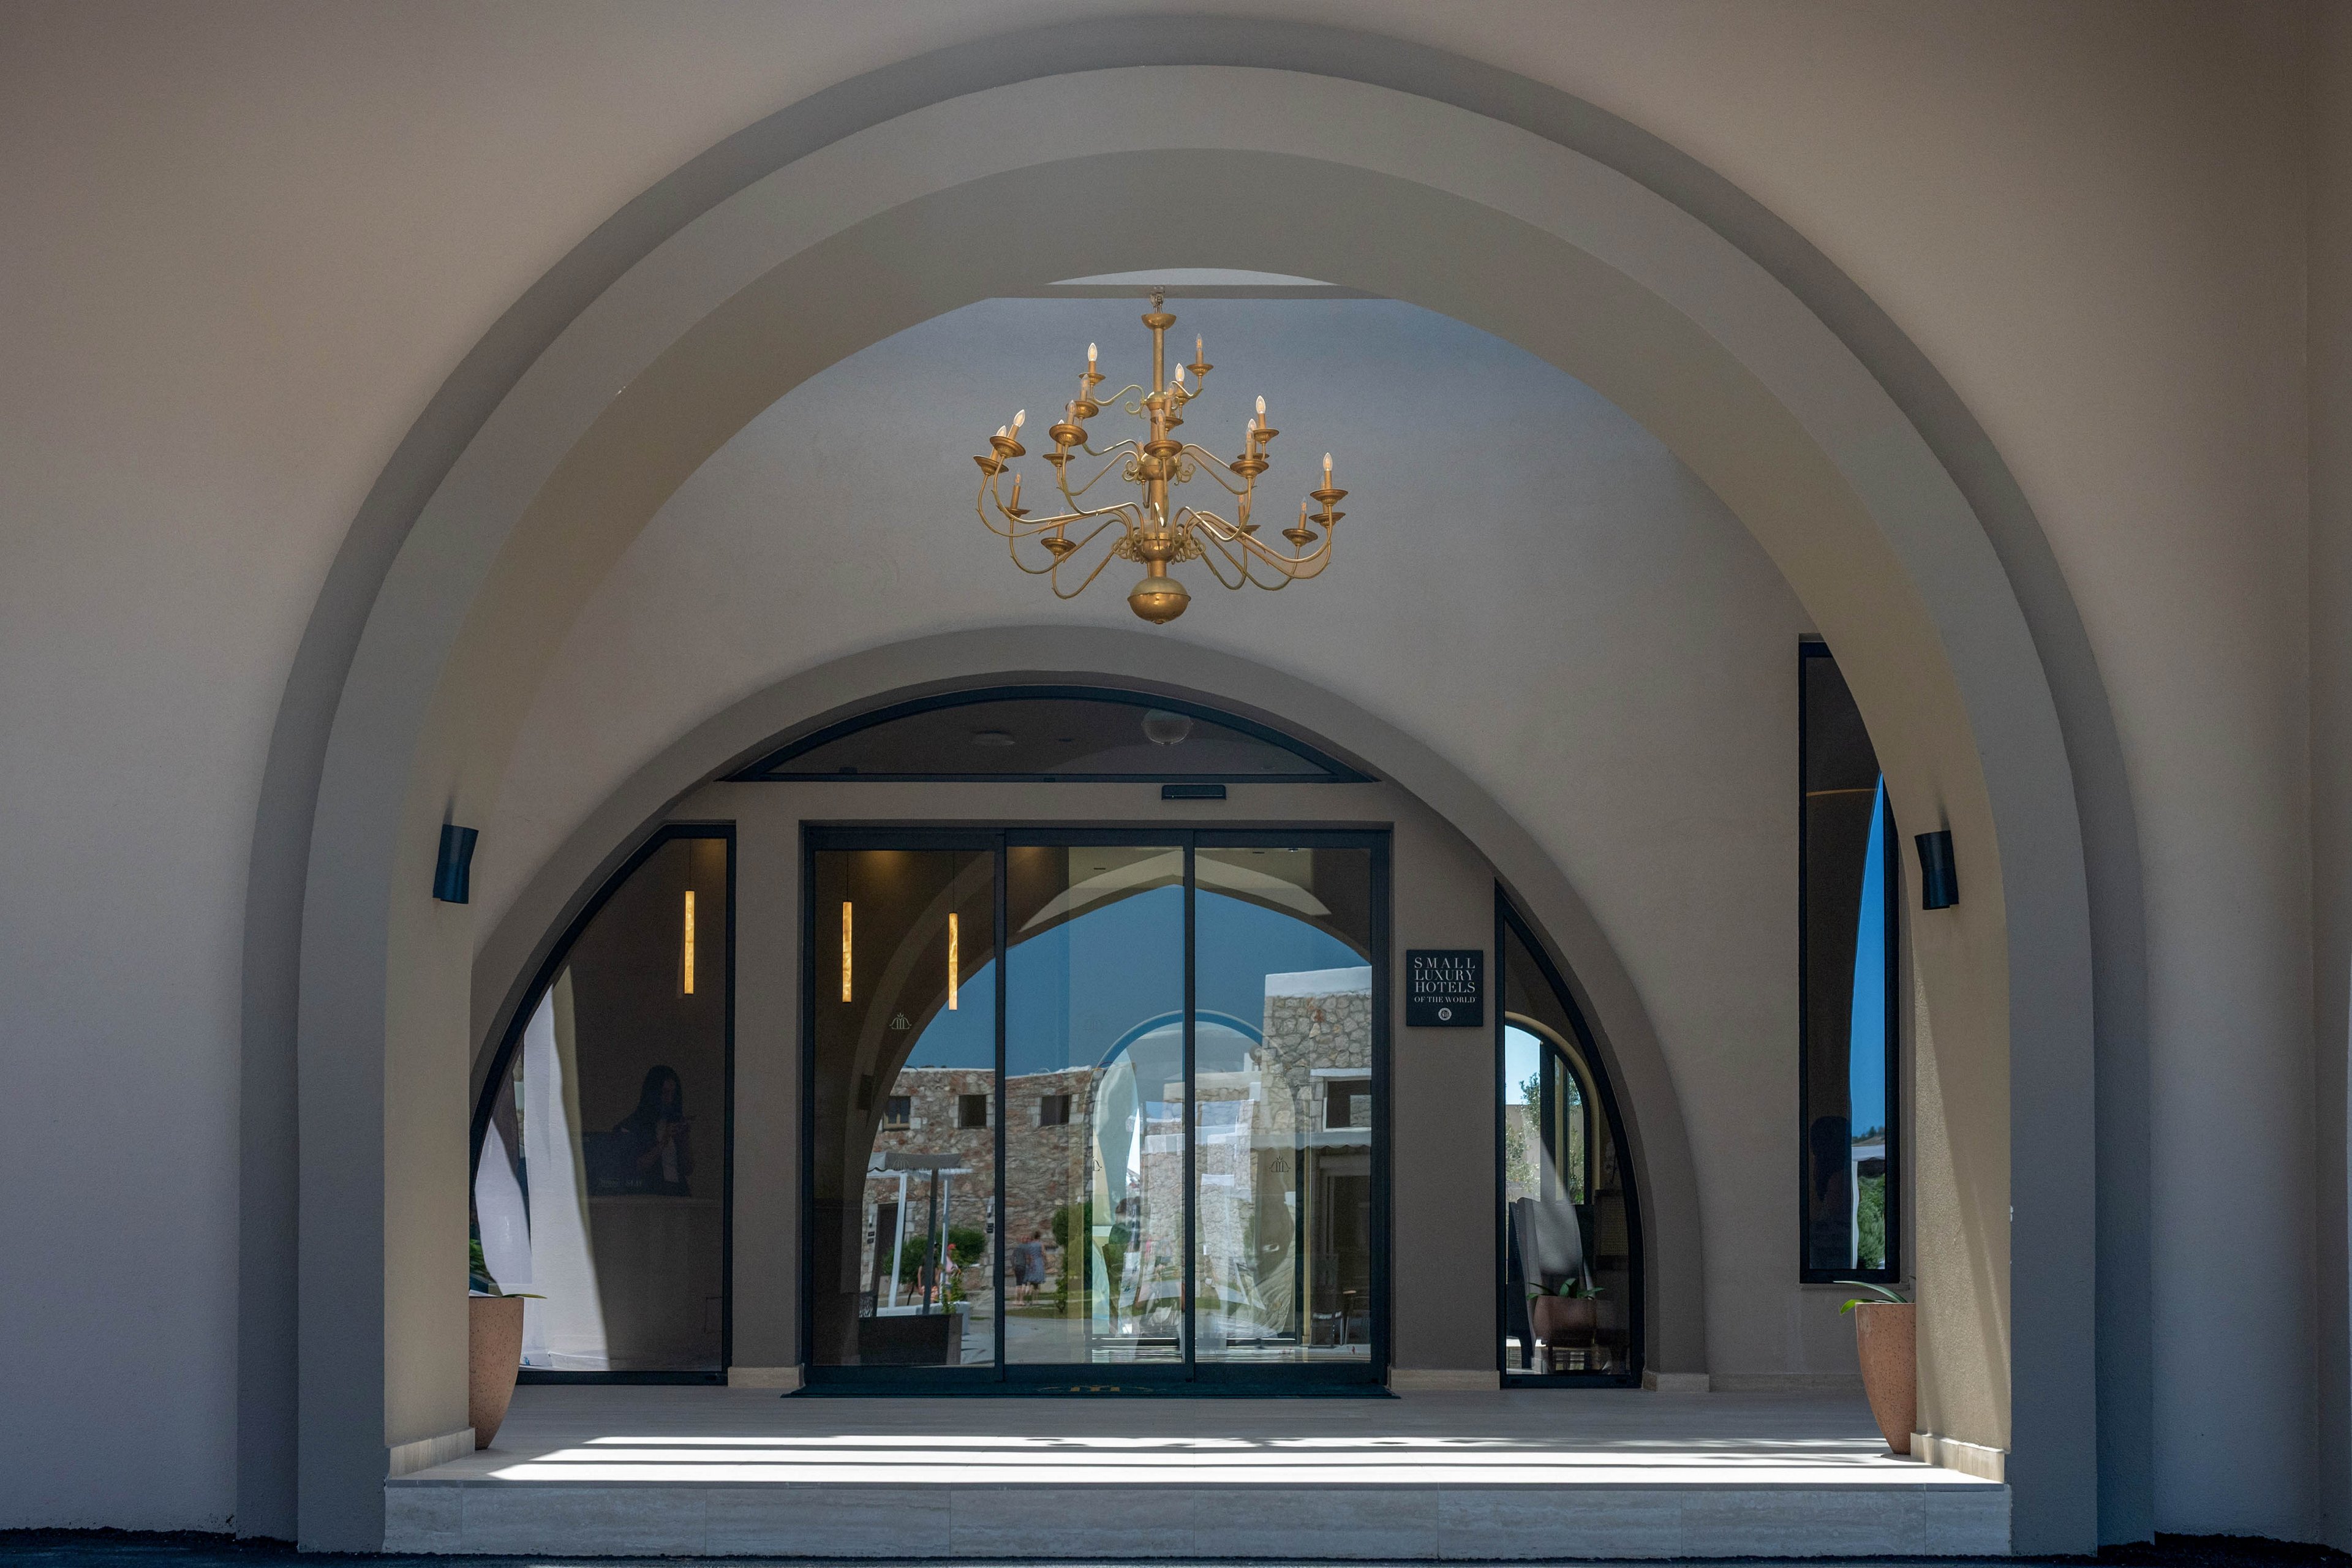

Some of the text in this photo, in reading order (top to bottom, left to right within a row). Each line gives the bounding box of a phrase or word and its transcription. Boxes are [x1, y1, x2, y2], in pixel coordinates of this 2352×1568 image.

[1414, 957, 1476, 968] SMALL
[1414, 970, 1475, 981] LUXURY
[1415, 981, 1476, 993] HOTELS
